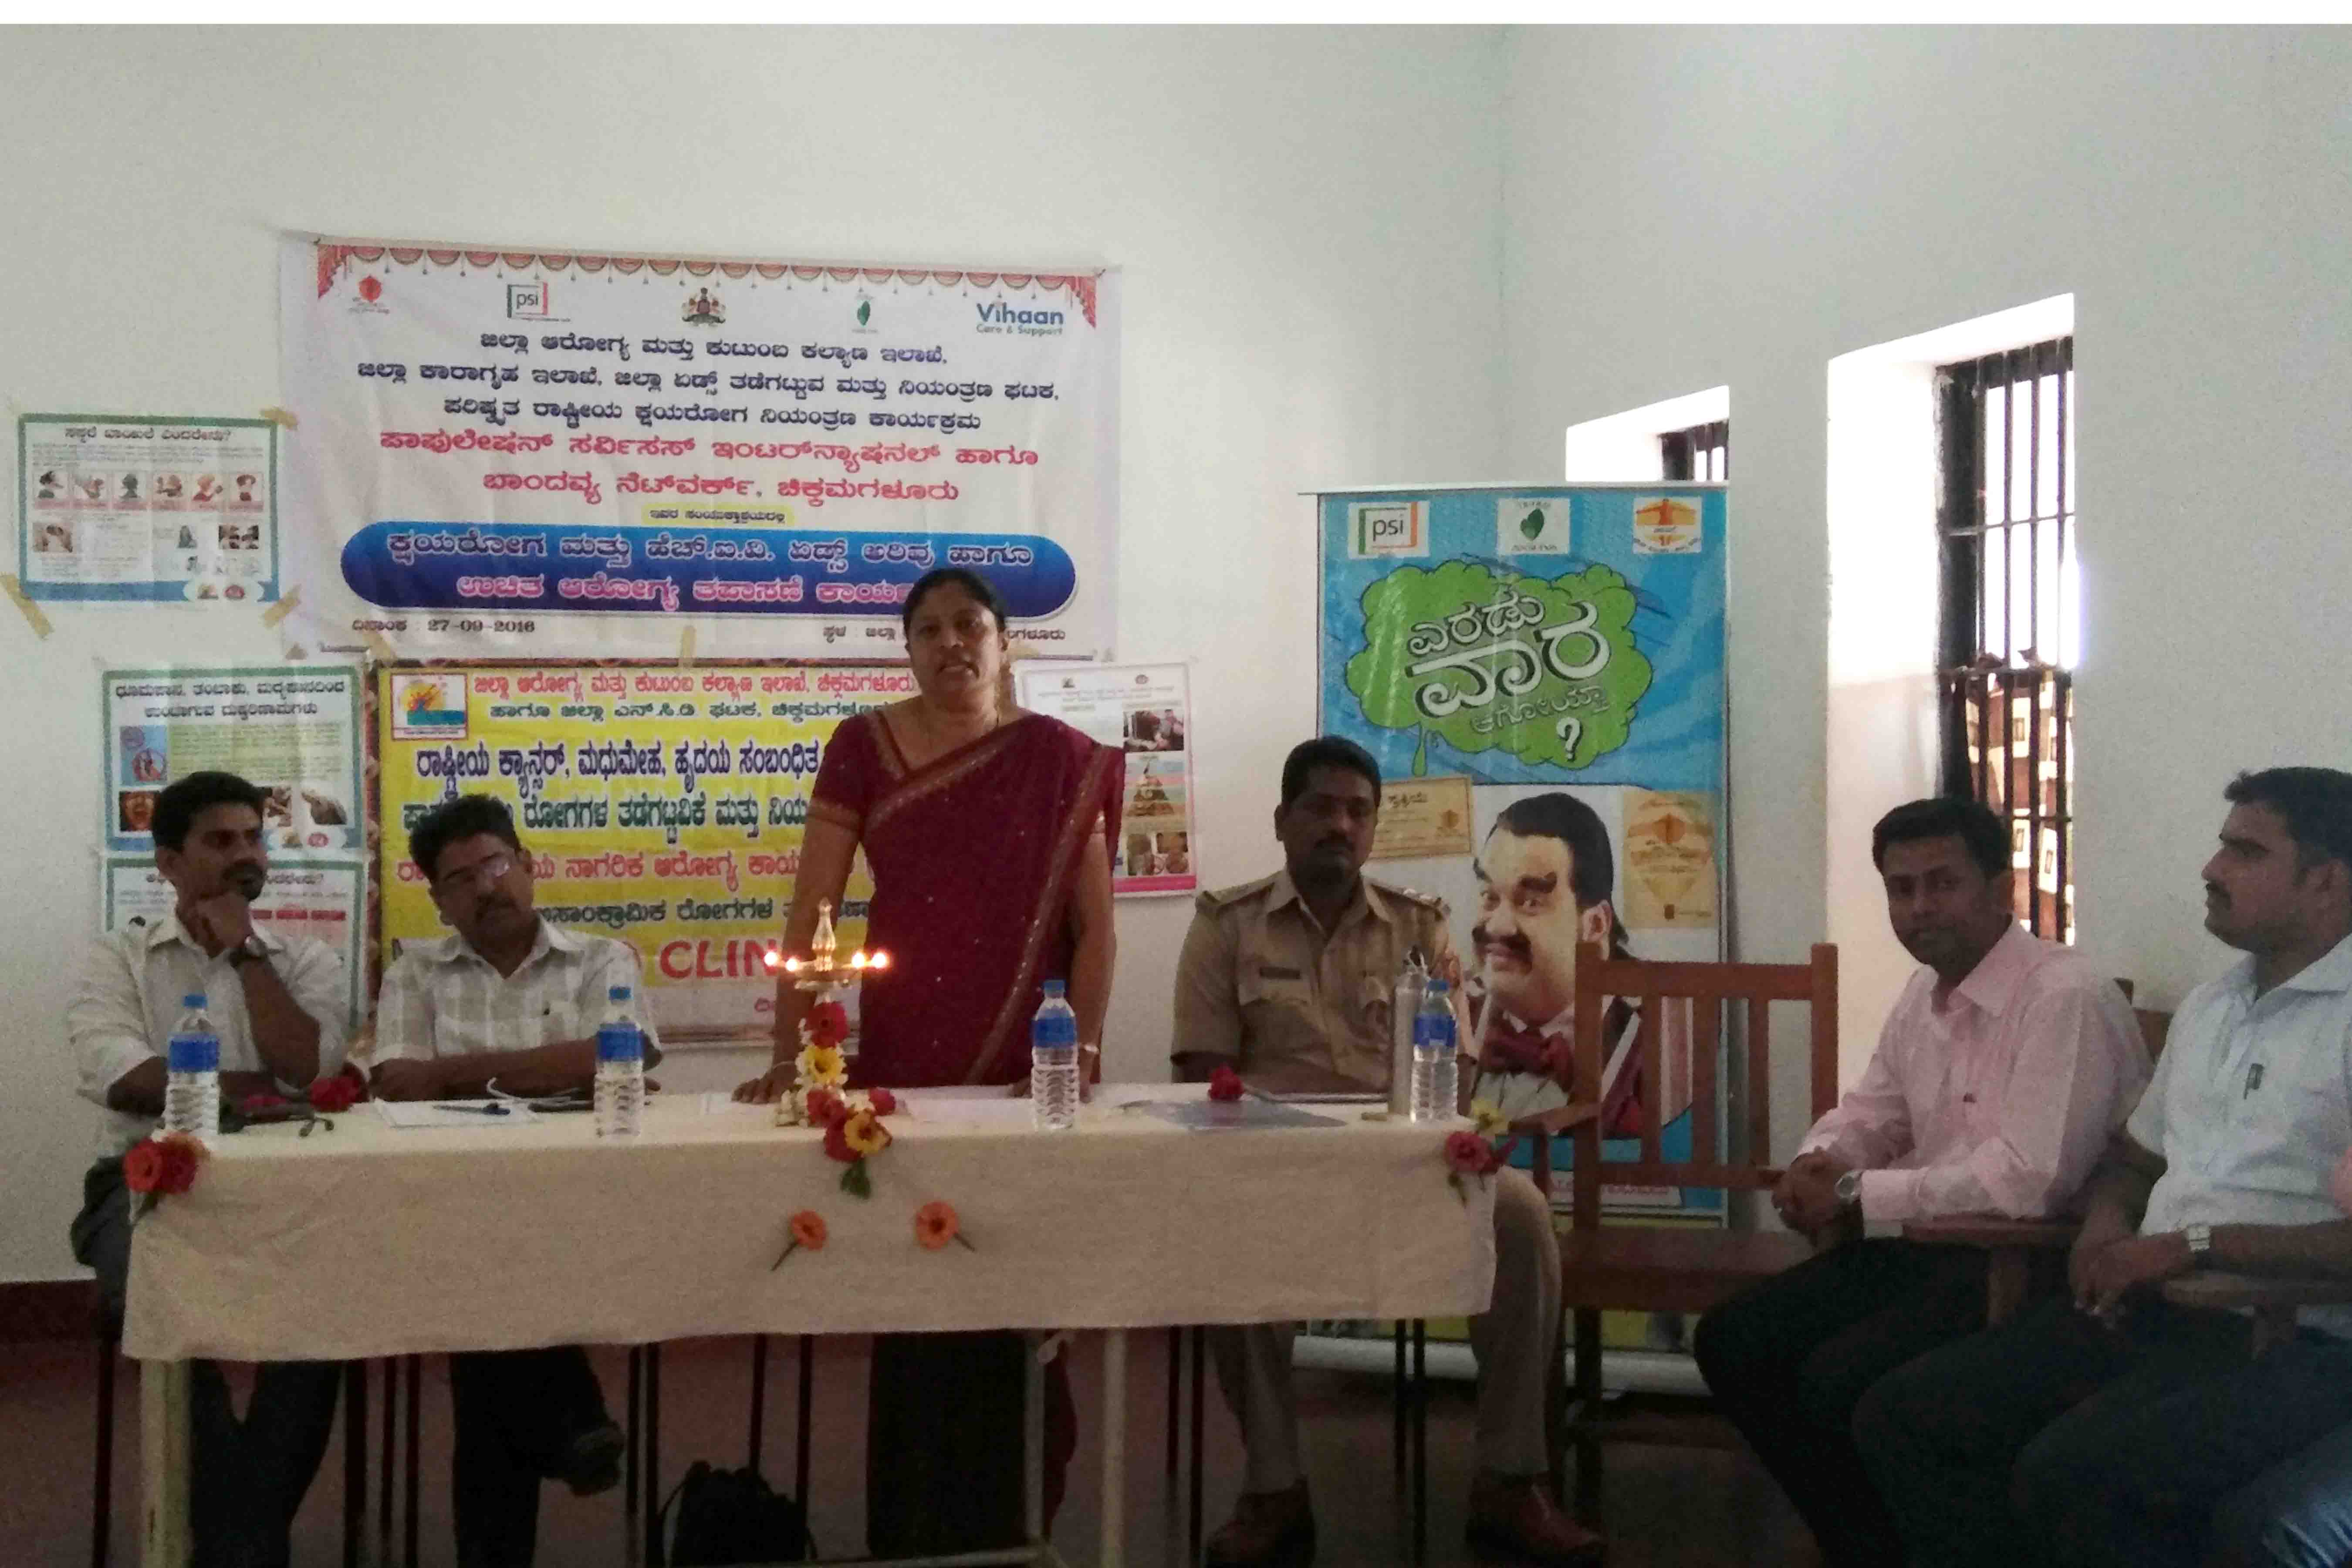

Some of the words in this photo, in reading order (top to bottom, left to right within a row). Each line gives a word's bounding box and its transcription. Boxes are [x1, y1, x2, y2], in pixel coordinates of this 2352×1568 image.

[516, 292, 539, 309] psi
[976, 302, 1064, 325] Vihaan
[976, 324, 1002, 335] Care
[1007, 325, 1013, 334] &
[1018, 325, 1063, 337] Support
[481, 332, 529, 354] ಜಿಲ್ಲಾ
[541, 332, 629, 358] ಆರೋಗ್ಯ
[642, 335, 693, 360] ಮತ್ತು
[706, 339, 789, 358] ಕುಟುಂಬ
[802, 340, 868, 368] ಕಲ್ಯಾಣ
[358, 361, 406, 383] ಜಿಲ್ಲಾ
[420, 362, 519, 389] ಕಾರಾಗೃಹ
[615, 369, 661, 392] ಜಿಲ್ಲಾ
[674, 371, 717, 395] ಏಡ್ಸ್
[837, 377, 887, 400] ಮತ್ತು
[899, 381, 992, 402] ನಿಯಂತ್ರಣ
[444, 397, 520, 426] ಪರಿಷ್ಕೃತ
[533, 402, 622, 429] ರಾಷ್ಟ್ರೀಯ
[635, 402, 747, 428] ಕ್ಷಯರೋಗ
[761, 408, 856, 431] ನಿಯಂತ್ರಣ
[869, 411, 980, 434] ಕಾರ್ಯಕ್ರಮ
[380, 428, 553, 454] ಪಾಪುಲೇಷನ್
[569, 433, 696, 456] ಸರ್ವಿಸಸ್
[956, 447, 1038, 466] ಹಾಗೂ
[483, 470, 602, 504] ಬಾಂದವ್ಯ
[778, 478, 960, 506] ಚಿಕ್ಕಮಗಳೂರು
[650, 509, 679, 519] ಇವರ
[1372, 514, 1403, 541] psi
[388, 527, 547, 566] ಕ್ಷಯರೋಗ
[560, 534, 632, 567] ಮತ್ತು
[789, 536, 848, 573] ಏಡ್ಸ್
[862, 538, 936, 566] ಅರಿವು
[948, 542, 1034, 565] ಹಾಗೂ
[456, 572, 544, 598] ಉಚಿತ
[558, 571, 680, 611] ಆರೋಗ್ಯ
[693, 574, 804, 602] ತಪಾಸಣೆ
[352, 619, 407, 632] ದಿನಾಂಕ
[1407, 588, 1545, 656] ಎರಡು
[1405, 600, 1611, 718] ವಾರ
[474, 675, 509, 698] ಜಿಲ್ಲಾ
[518, 671, 584, 702] ಆರೋಗ್ಯ
[591, 672, 626, 699] ಮತ್ತು
[635, 672, 693, 692] ಕುಟುಂಬ
[702, 672, 752, 701] ಕಲ್ಯಾಣ
[491, 702, 550, 717] ಹಾಗೂ
[561, 704, 604, 721] ಜಿಲ್ಲಾ
[1556, 717, 1583, 762] ?
[416, 740, 490, 800] ರಾಷ್ಟ್ರೀಯ
[675, 740, 730, 793] ಹೃದಯ
[739, 740, 819, 780] ಸಂಬಂಧಿತ
[524, 794, 608, 828] ರೋಗಗಳ
[716, 792, 759, 838] ಮತ್ತು
[565, 852, 644, 879] ನಾಗರಿಕ
[655, 850, 739, 892] ಆರೋಗ್ಯ
[676, 897, 773, 922] ರೋಗಗಳ
[659, 939, 778, 979] CLIN
